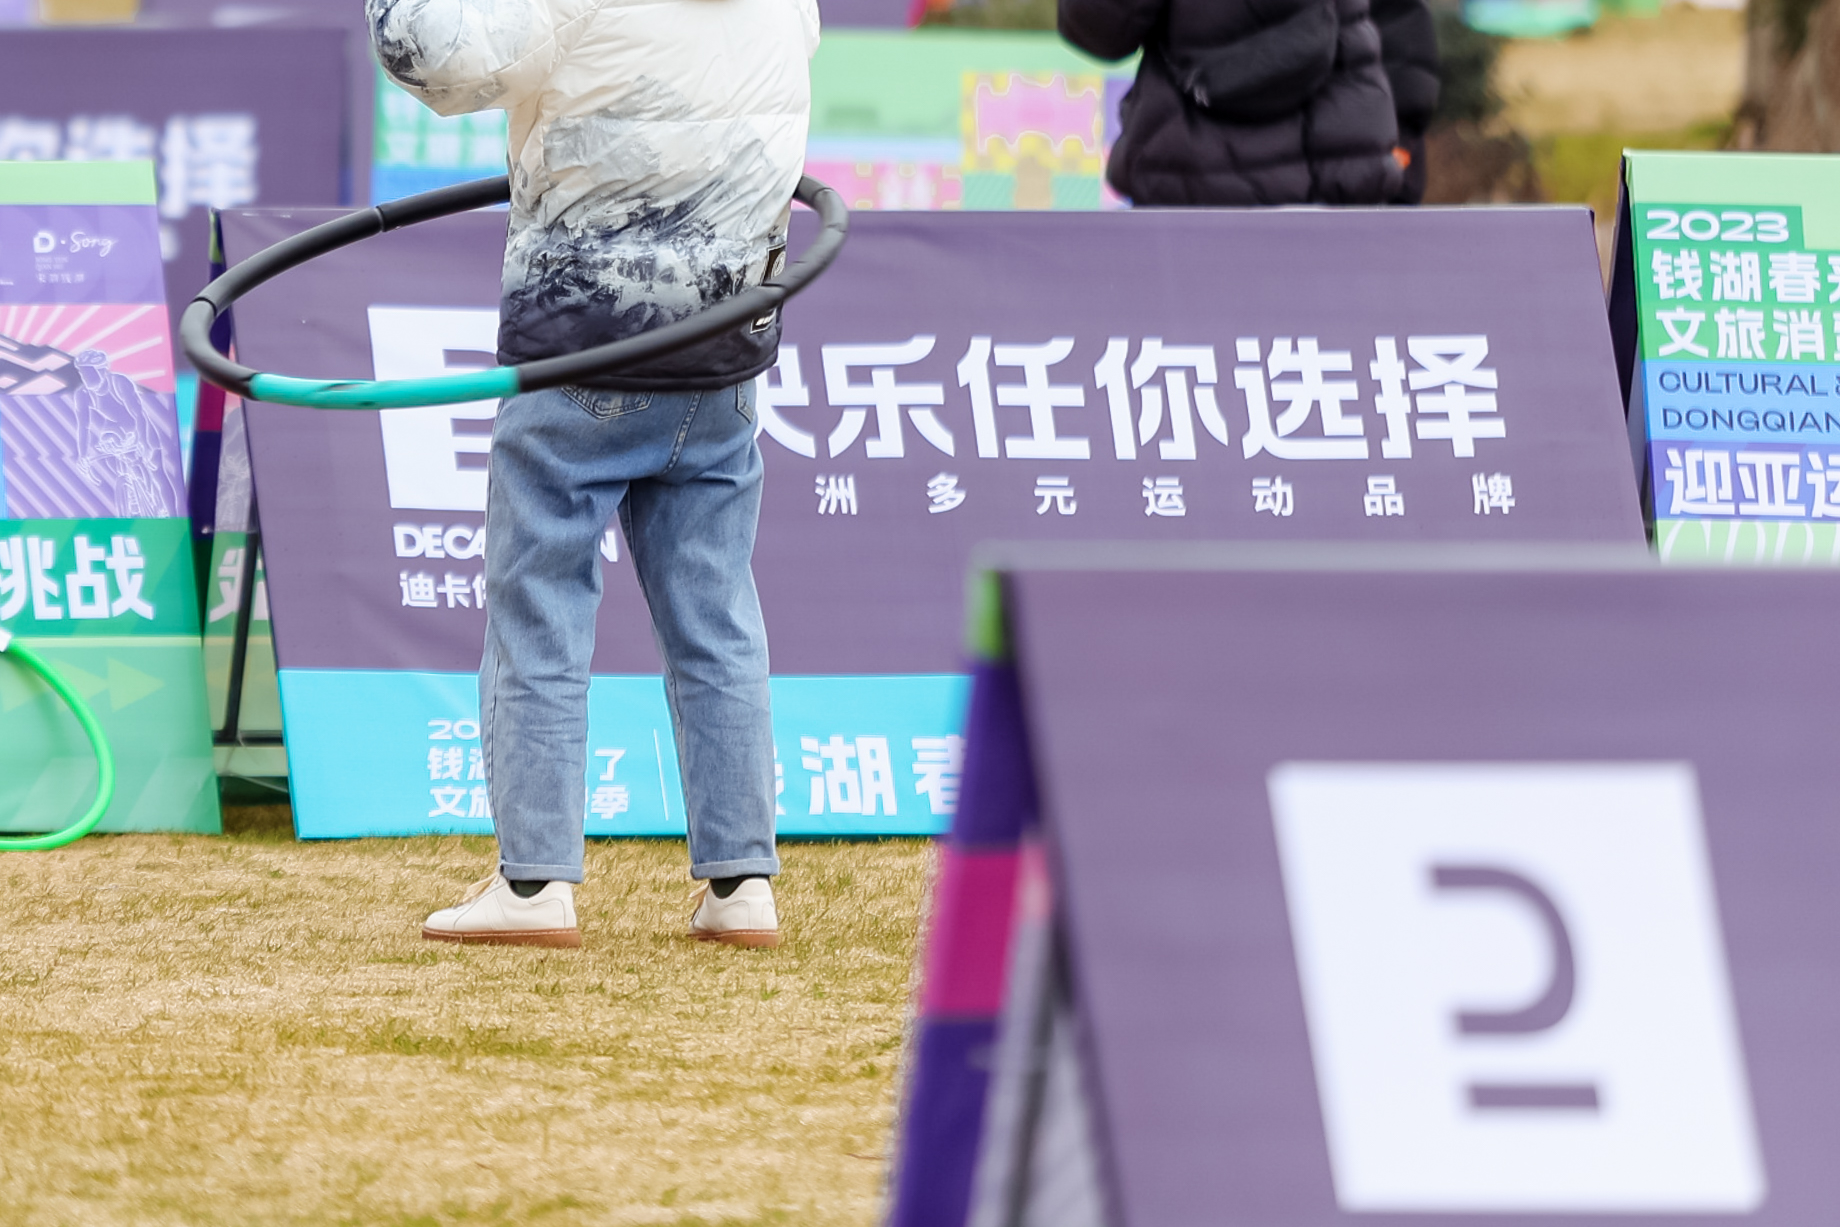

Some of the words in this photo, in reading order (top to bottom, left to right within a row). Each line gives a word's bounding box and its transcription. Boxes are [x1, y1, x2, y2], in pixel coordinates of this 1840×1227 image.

[1646, 210, 1789, 242] 2023
[1651, 248, 1840, 303] 钱湖春
[1656, 307, 1840, 361] 文旅消
[1659, 371, 1828, 397] CULTURAL
[775, 734, 966, 817] 湖春
